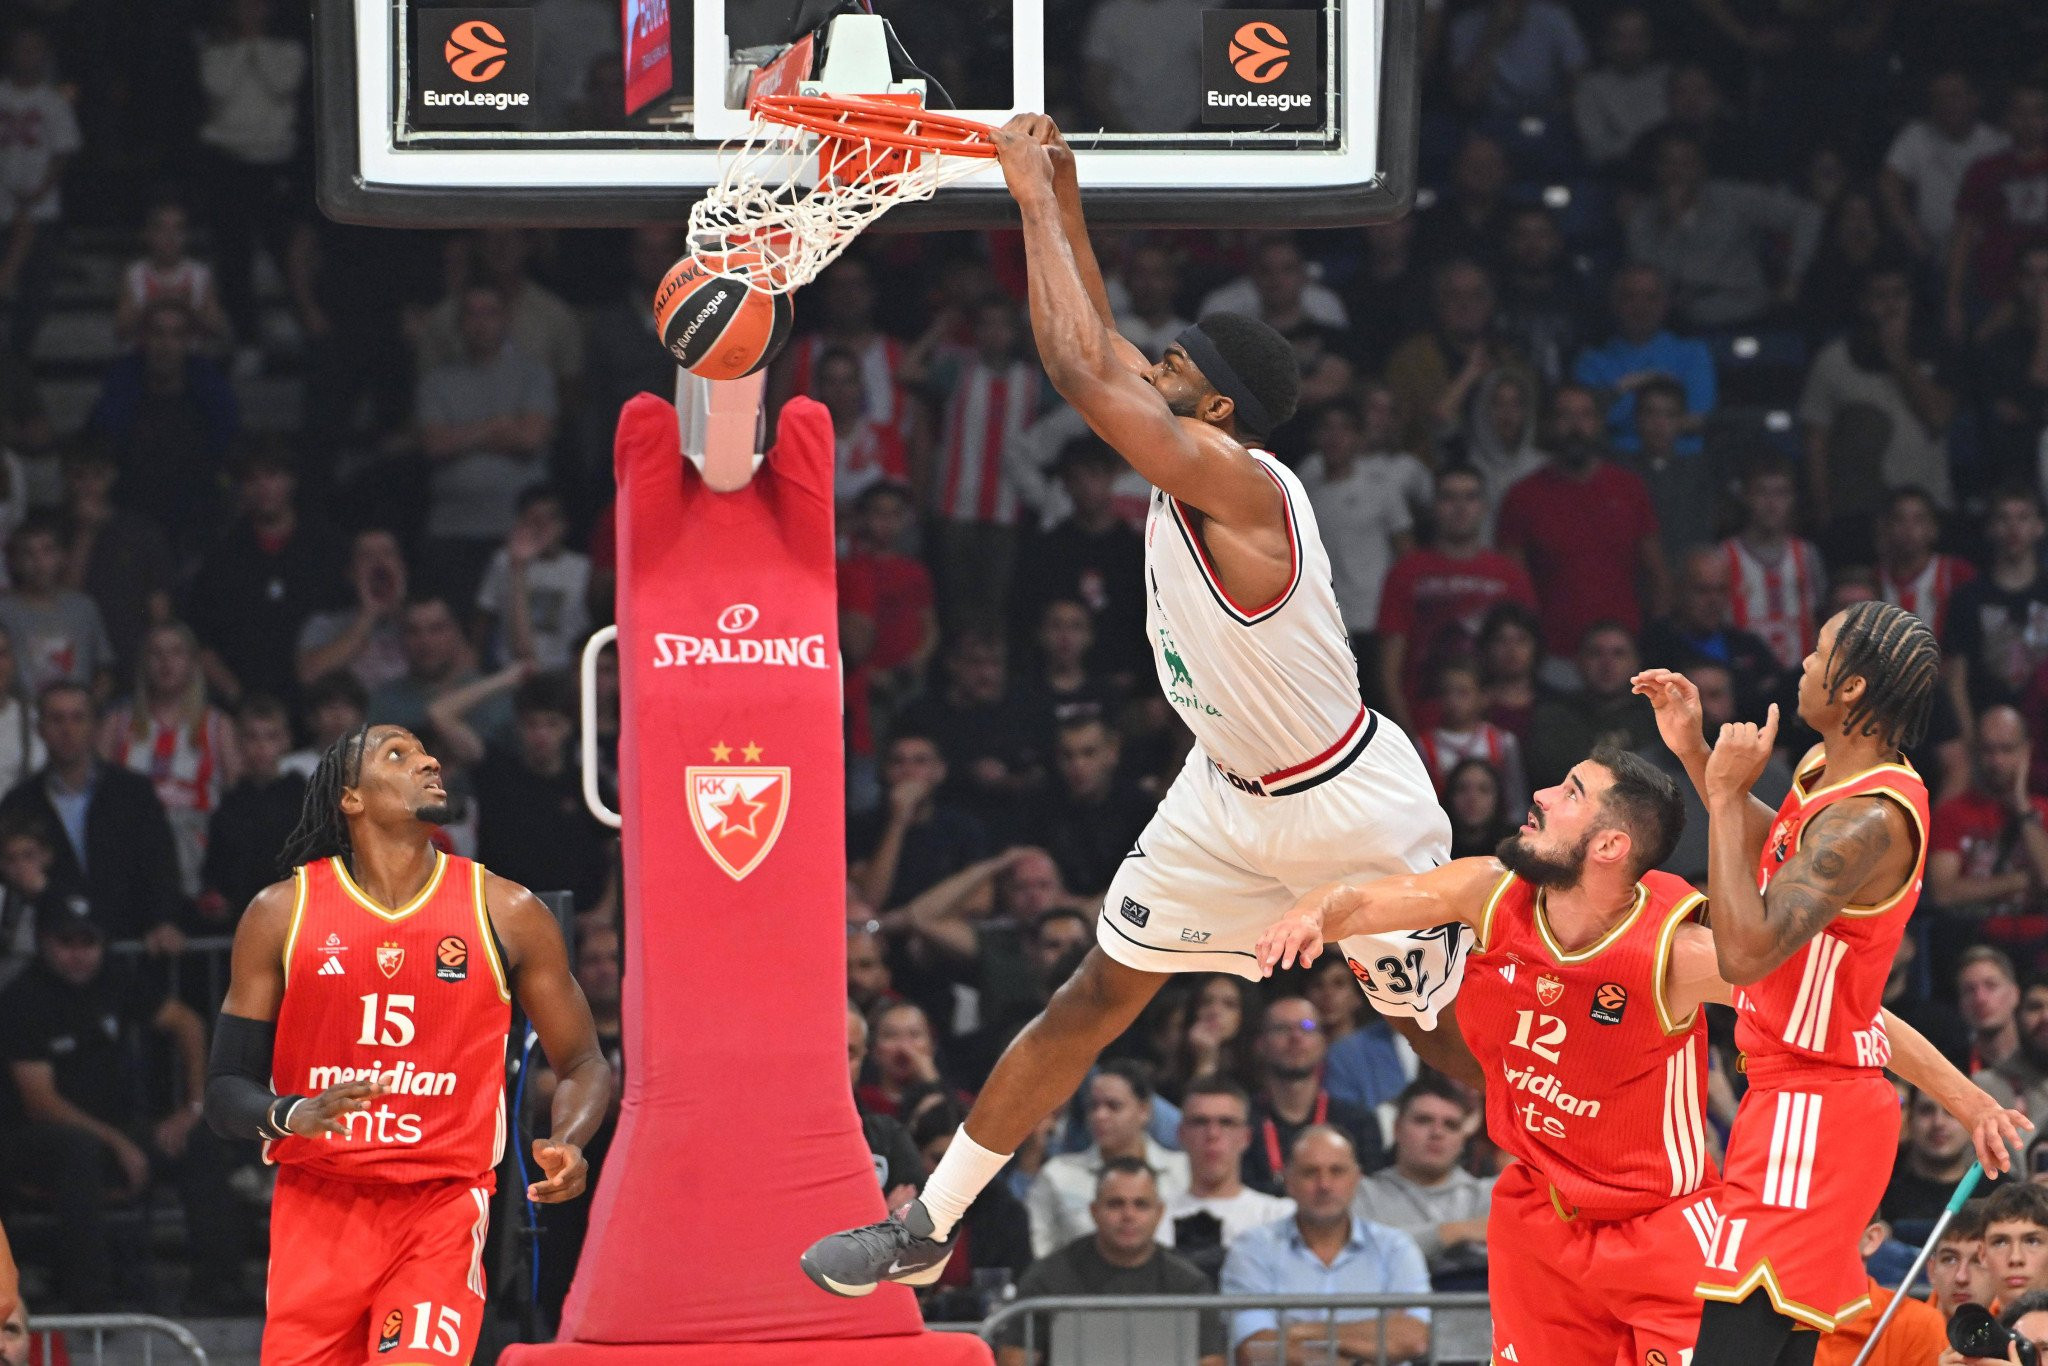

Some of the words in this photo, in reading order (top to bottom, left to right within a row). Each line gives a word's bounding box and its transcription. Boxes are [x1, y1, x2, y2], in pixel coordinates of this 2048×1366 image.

[424, 90, 529, 110] EuroLeague
[1207, 90, 1311, 111] EuroLeague
[677, 290, 727, 348] EuroLeague
[653, 633, 826, 669] SPALDING
[700, 779, 725, 795] KK
[1123, 899, 1147, 917] EA7
[1181, 928, 1212, 942] EA7
[1375, 948, 1429, 997] 32
[356, 992, 415, 1047] 15
[1509, 1010, 1567, 1064] 12
[309, 1060, 456, 1096] meridian
[1503, 1057, 1600, 1118] ridian
[1514, 1102, 1566, 1138] ts
[1705, 1214, 1748, 1272] 11
[408, 1301, 461, 1357] 15
